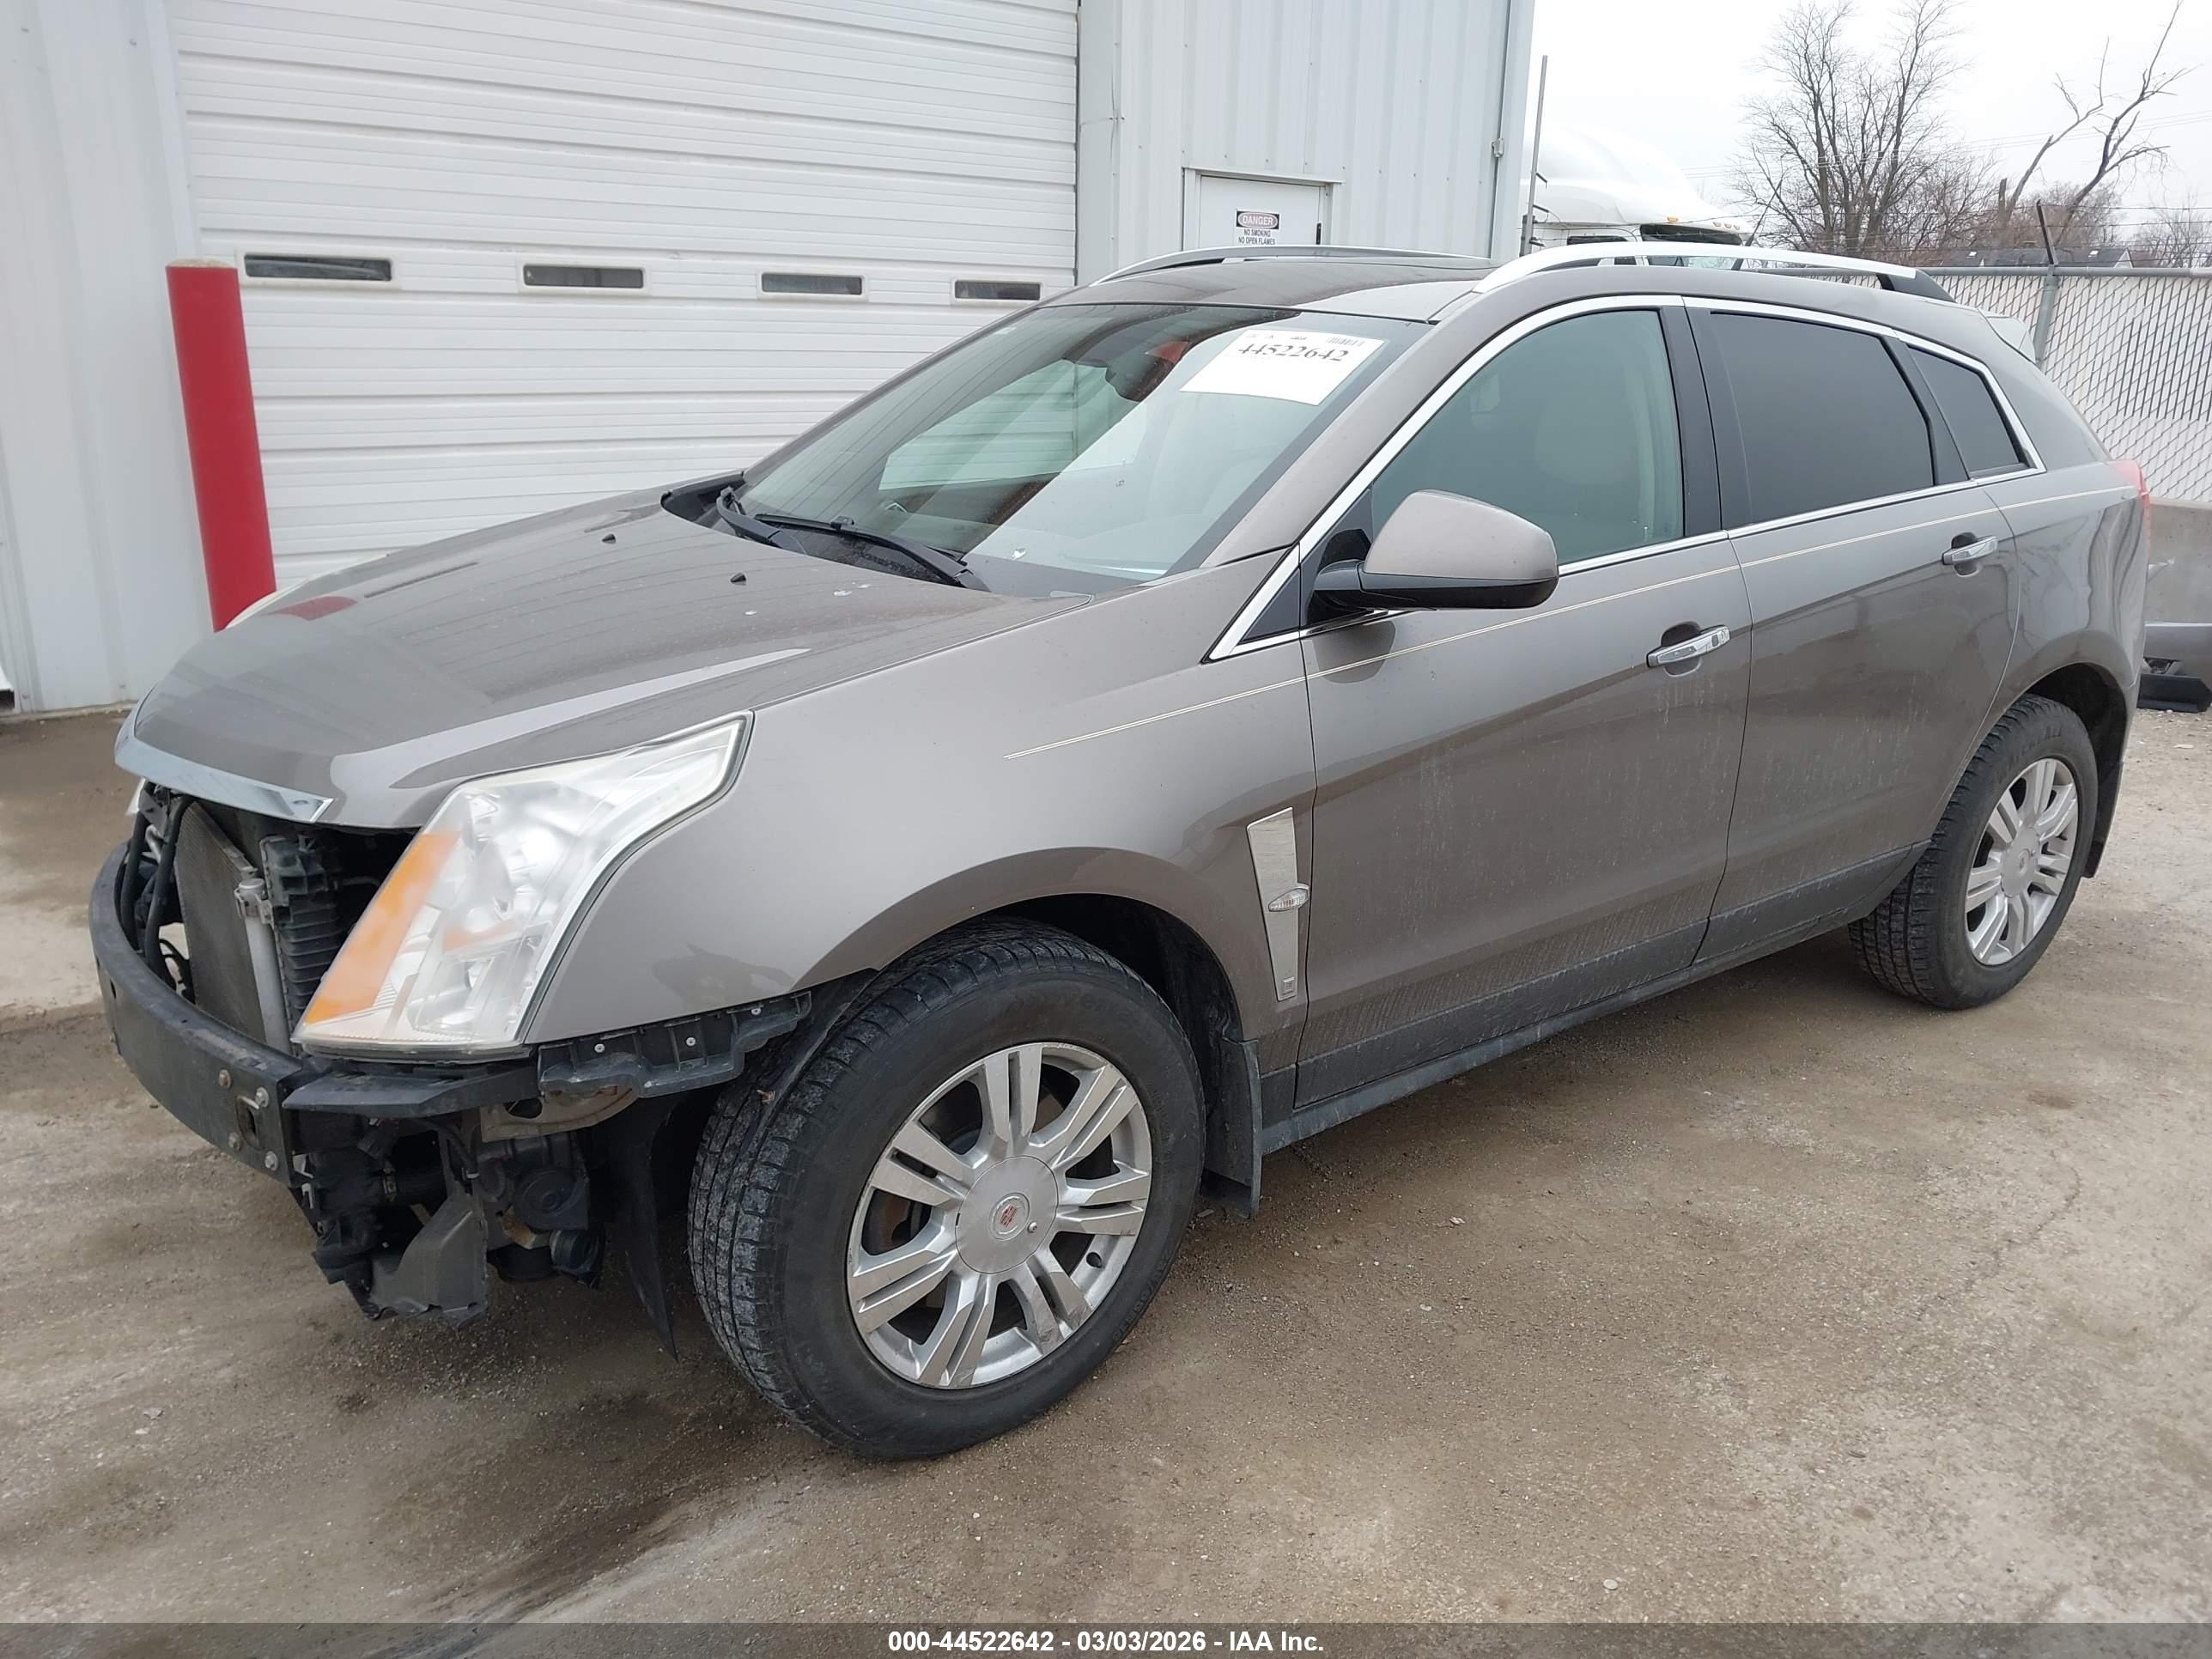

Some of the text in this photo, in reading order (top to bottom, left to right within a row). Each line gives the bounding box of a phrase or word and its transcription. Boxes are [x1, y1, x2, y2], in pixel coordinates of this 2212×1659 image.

[1243, 216, 1273, 225] DANGER
[1251, 228, 1271, 237] SMOKING
[1238, 343, 1349, 362] 44522642
